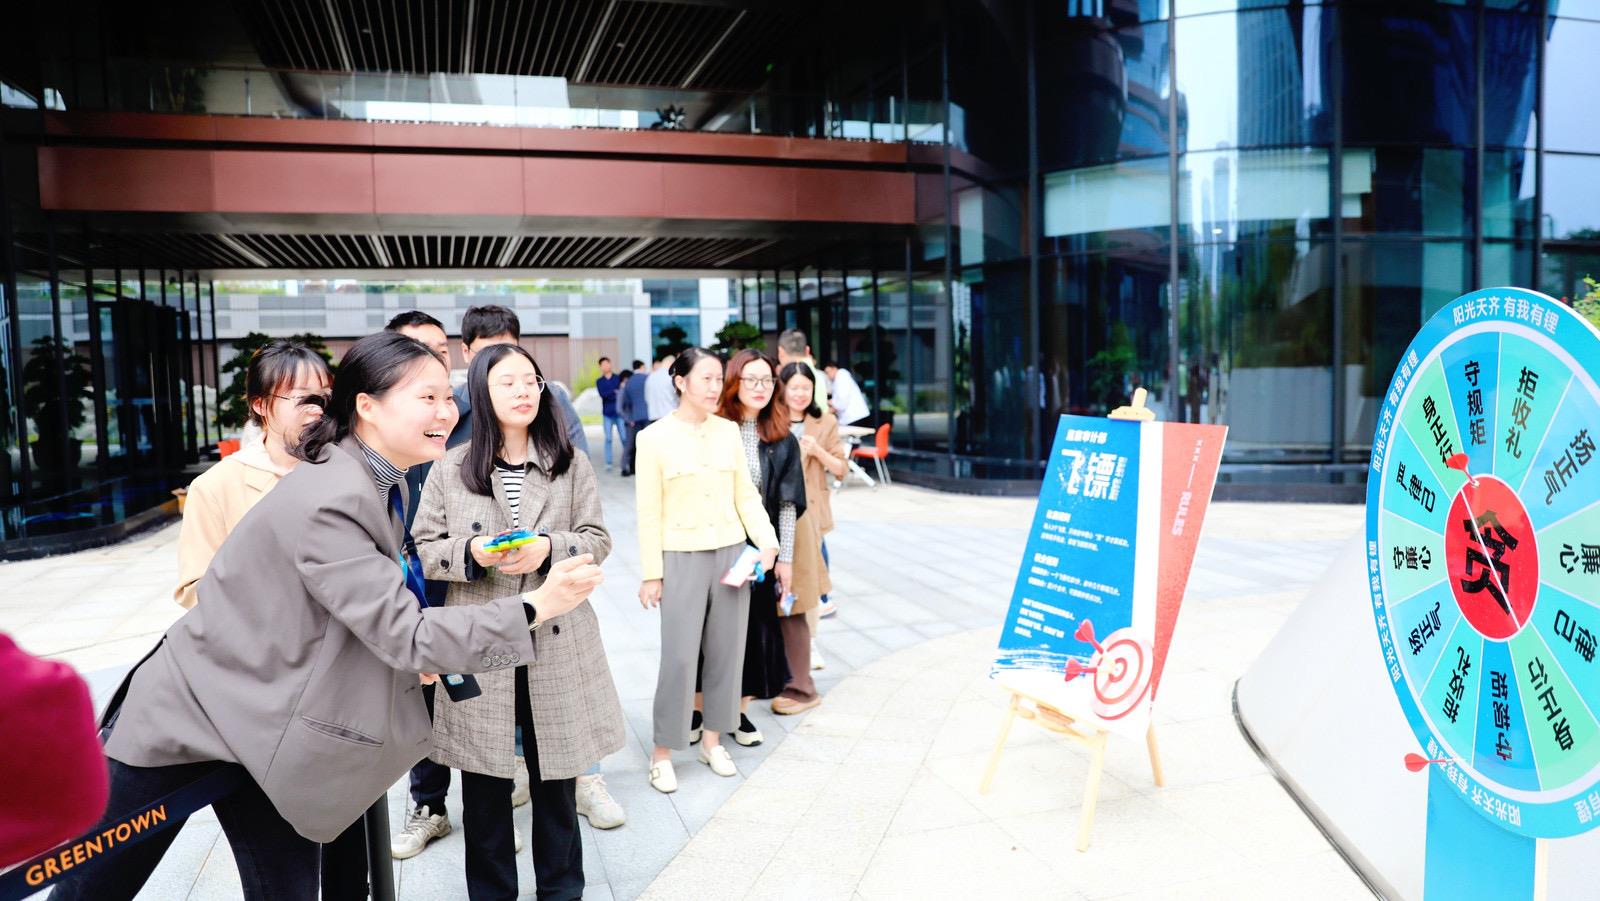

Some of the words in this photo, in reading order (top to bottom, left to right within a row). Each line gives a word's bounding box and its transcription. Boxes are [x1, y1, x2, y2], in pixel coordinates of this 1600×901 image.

[1452, 297, 1501, 326] 阳光天齐
[1503, 297, 1559, 335] 有我有锂
[1372, 407, 1393, 472] 阳光天齐
[1388, 348, 1420, 408] 有我有锂
[1464, 360, 1486, 446] 守规矩
[1505, 366, 1539, 459] 拒收礼
[1060, 448, 1117, 500] 飞镖
[1396, 462, 1436, 513] 严律己
[1543, 429, 1596, 505] 扬正气
[1393, 546, 1432, 570] 守廉心
[1460, 510, 1519, 616] 贪
[1377, 614, 1402, 683] 阳光天齐
[1408, 601, 1441, 656] 扬正气
[1442, 645, 1471, 724] 拒收礼
[1490, 670, 1513, 761] 守规矩
[1528, 656, 1574, 751] 身正行
[1471, 784, 1521, 827] 阳光天齐
[25, 804, 167, 886] GREENTOWN
